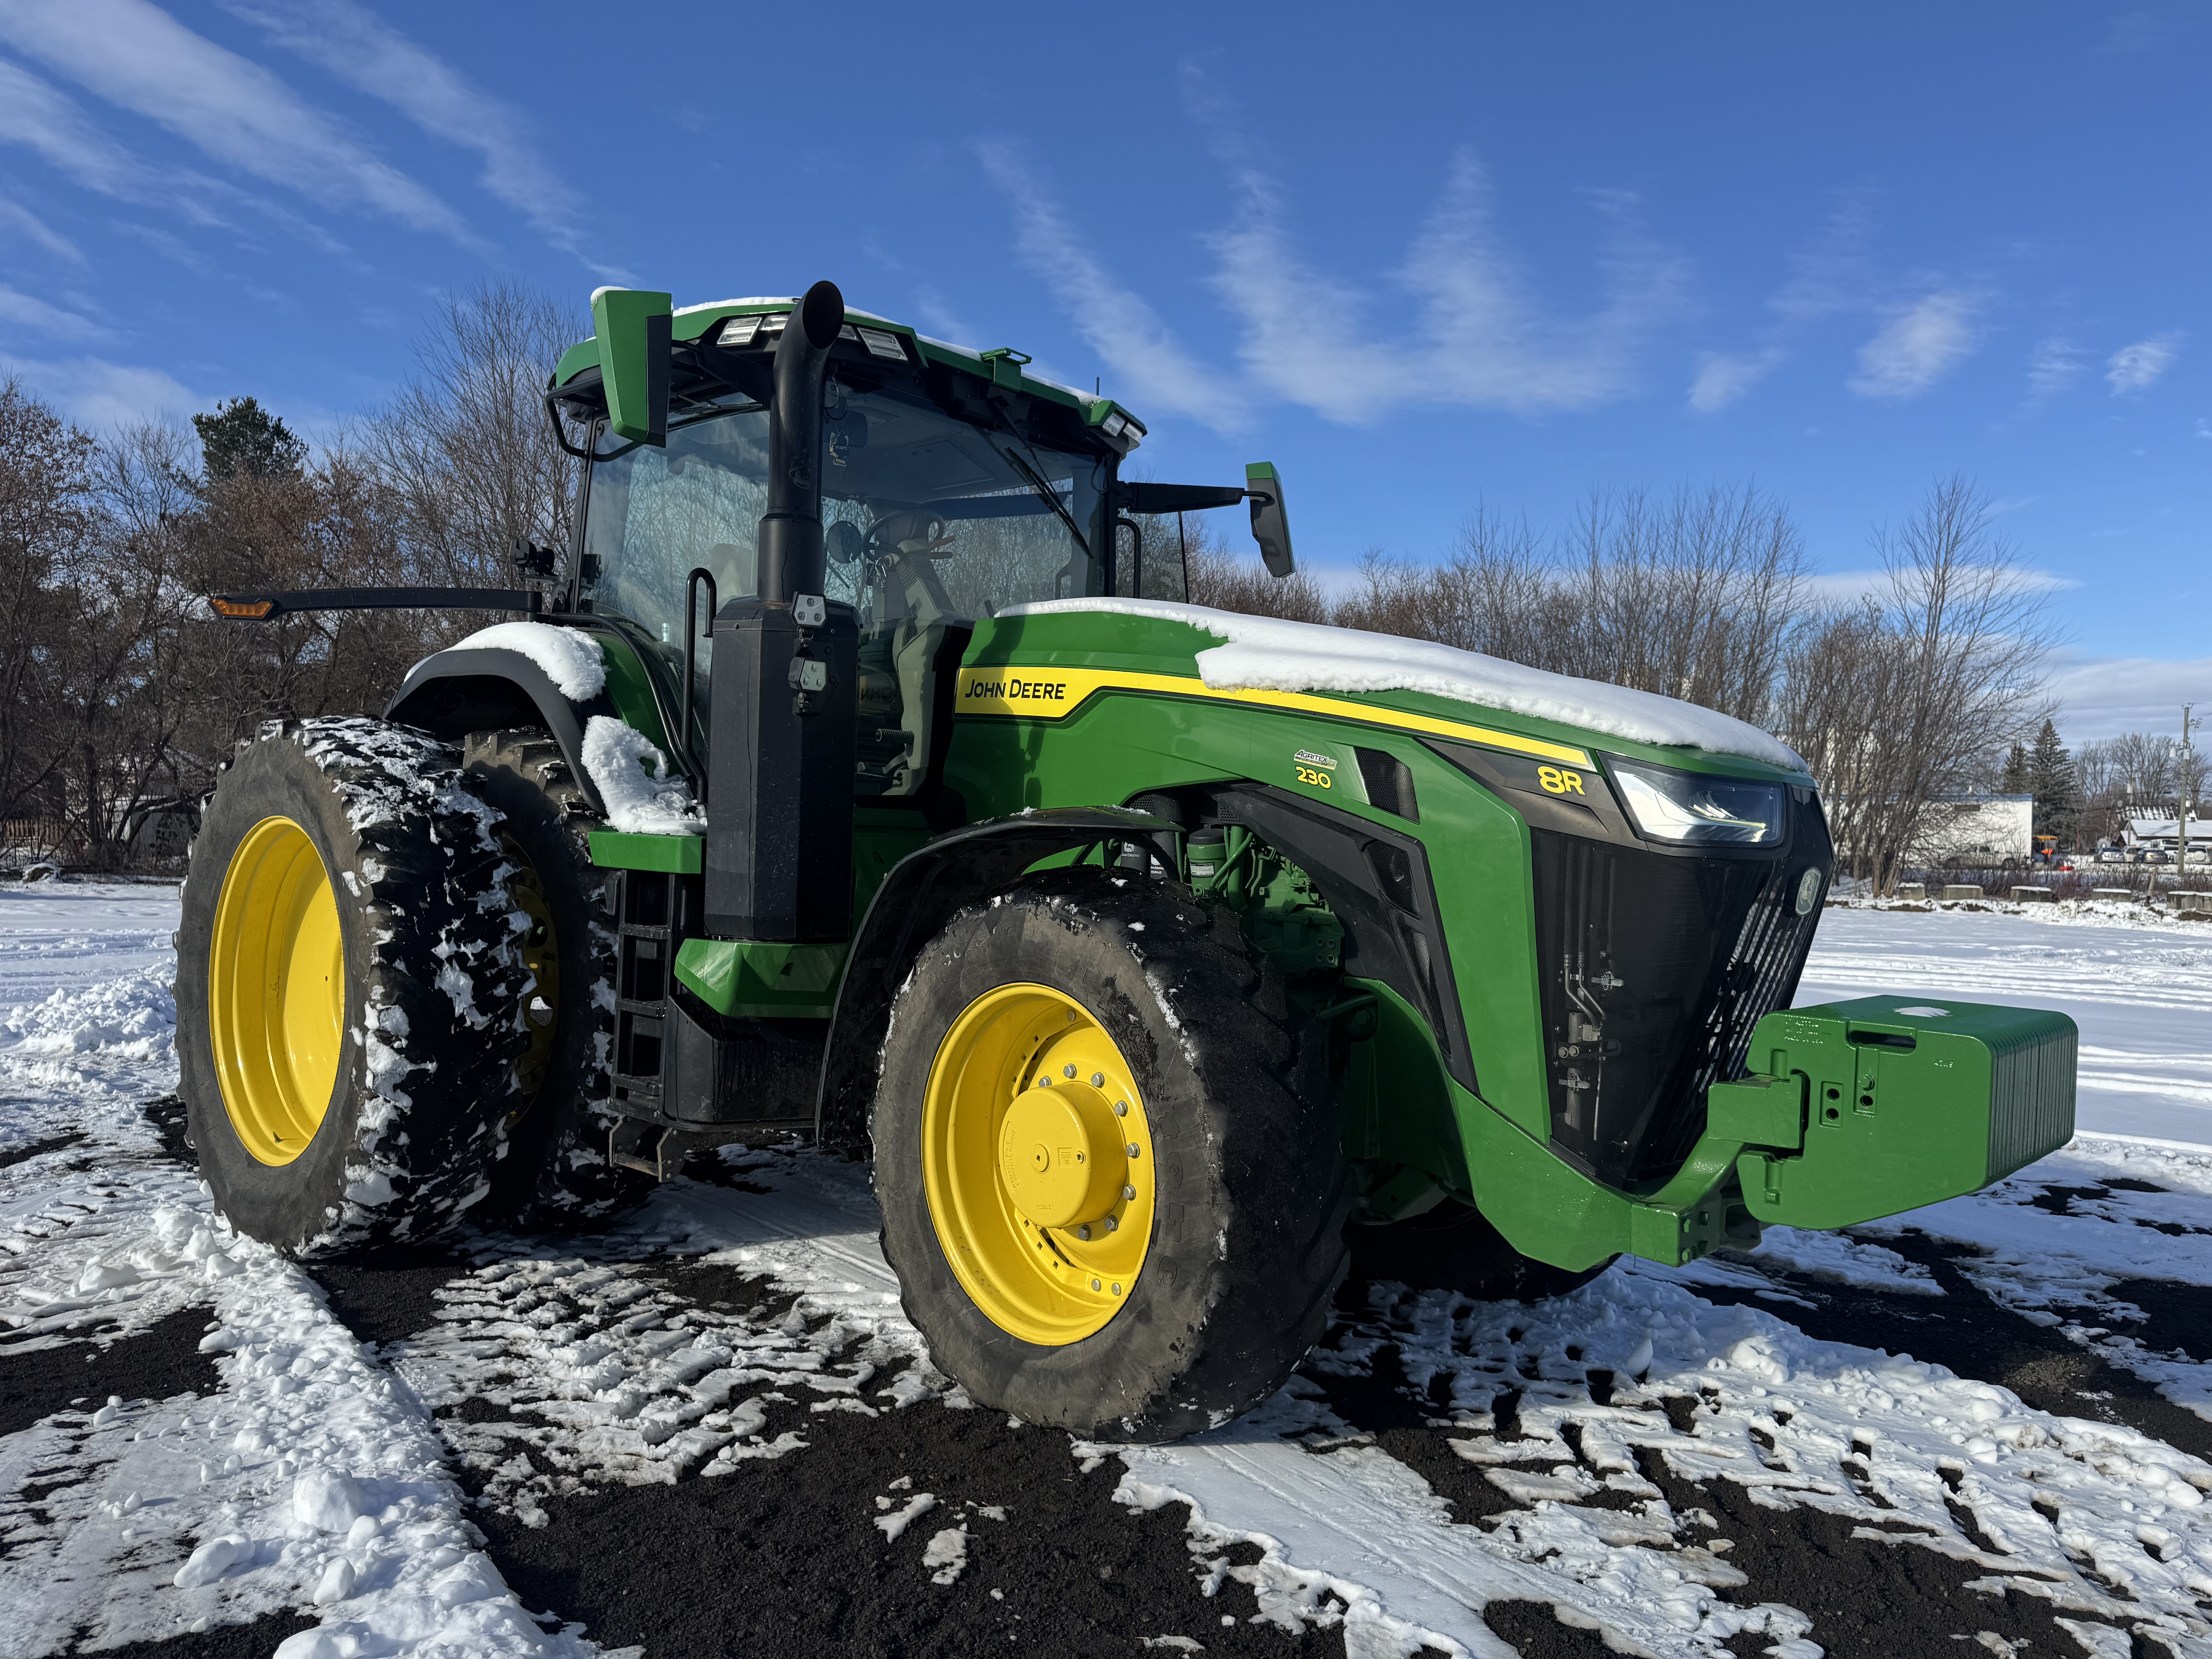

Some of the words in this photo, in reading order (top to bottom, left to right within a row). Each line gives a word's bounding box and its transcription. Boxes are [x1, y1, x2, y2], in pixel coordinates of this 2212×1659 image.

[965, 679, 1006, 698] JOHN
[1009, 679, 1066, 699] DEERE
[1296, 750, 1328, 763] AGRITEX
[1296, 766, 1331, 788] 230
[1537, 766, 1585, 795] 8R
